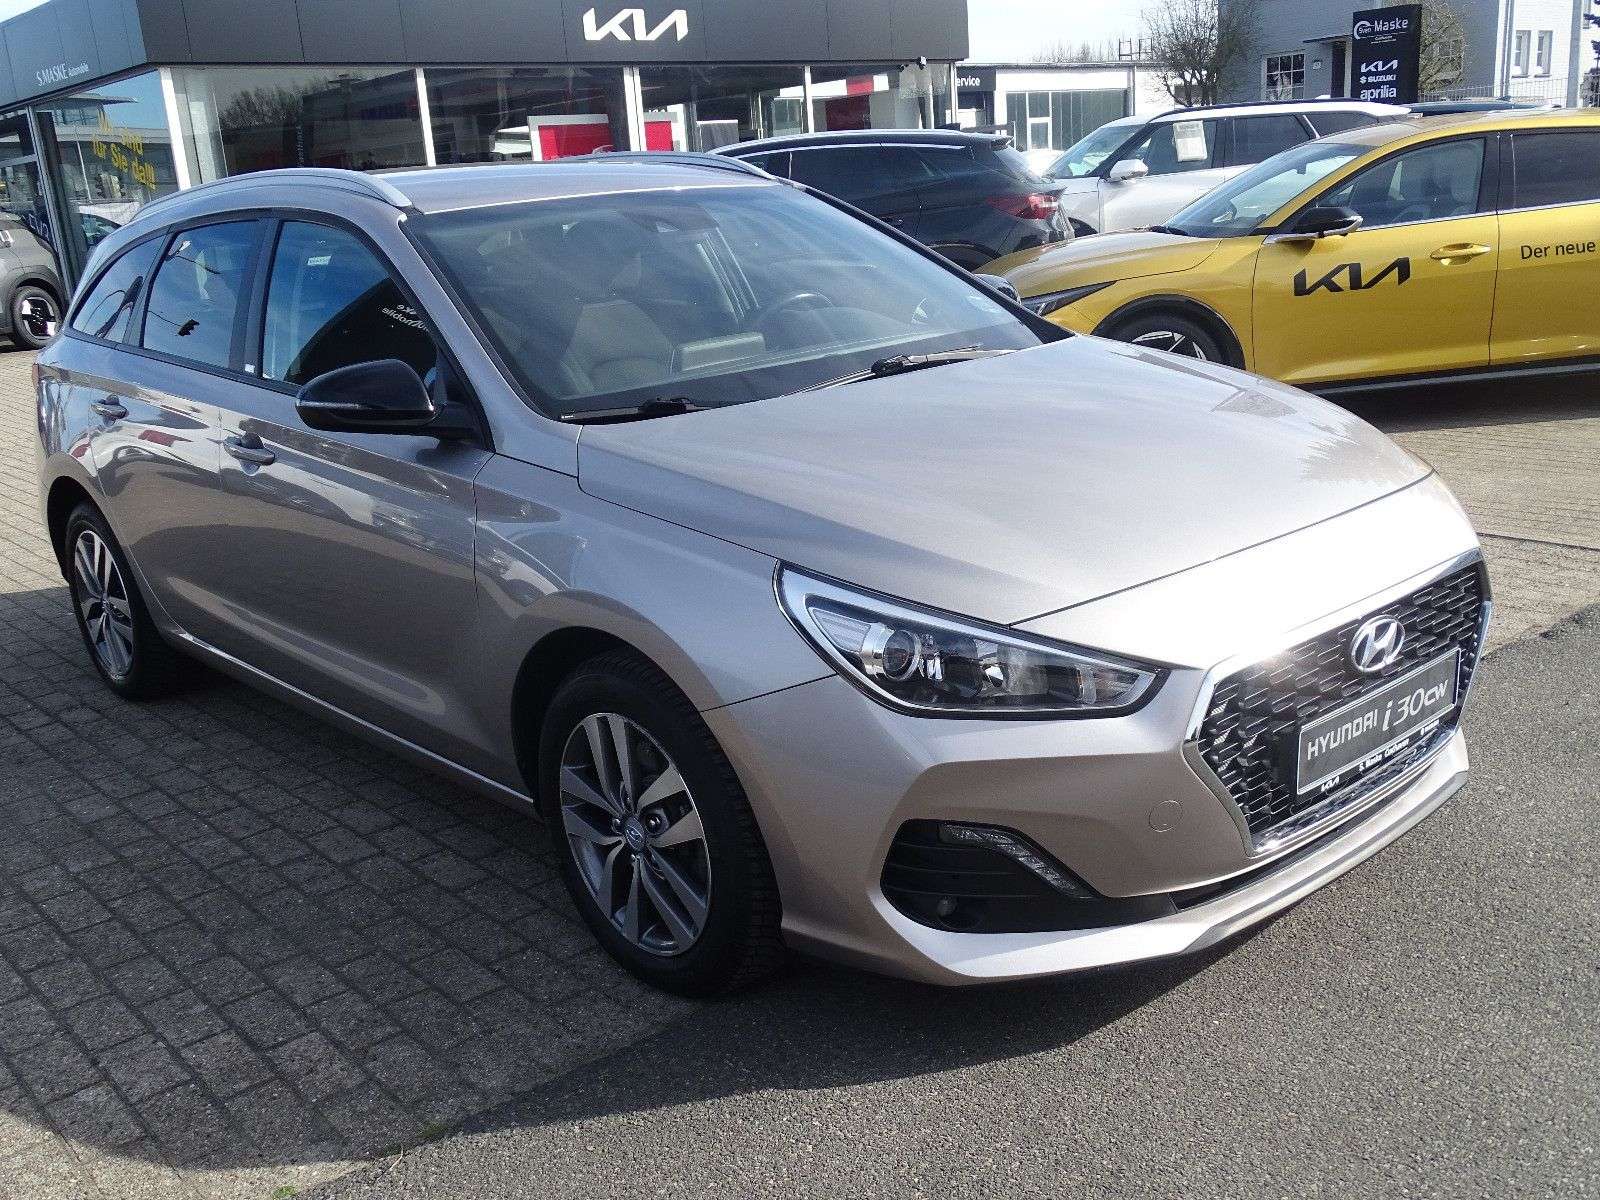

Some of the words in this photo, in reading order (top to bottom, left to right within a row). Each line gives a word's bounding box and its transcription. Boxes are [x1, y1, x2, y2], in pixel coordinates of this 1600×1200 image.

[582, 8, 688, 41] KIA
[1374, 17, 1408, 31] Maske
[1361, 60, 1398, 73] KIA
[955, 75, 980, 87] ervice
[1368, 74, 1396, 82] SUZUKI
[1360, 85, 1397, 101] aprilia
[1520, 244, 1550, 260] Der
[1555, 240, 1596, 256] neue
[1294, 257, 1410, 296] KIA
[1307, 709, 1378, 760] HYUNDAI
